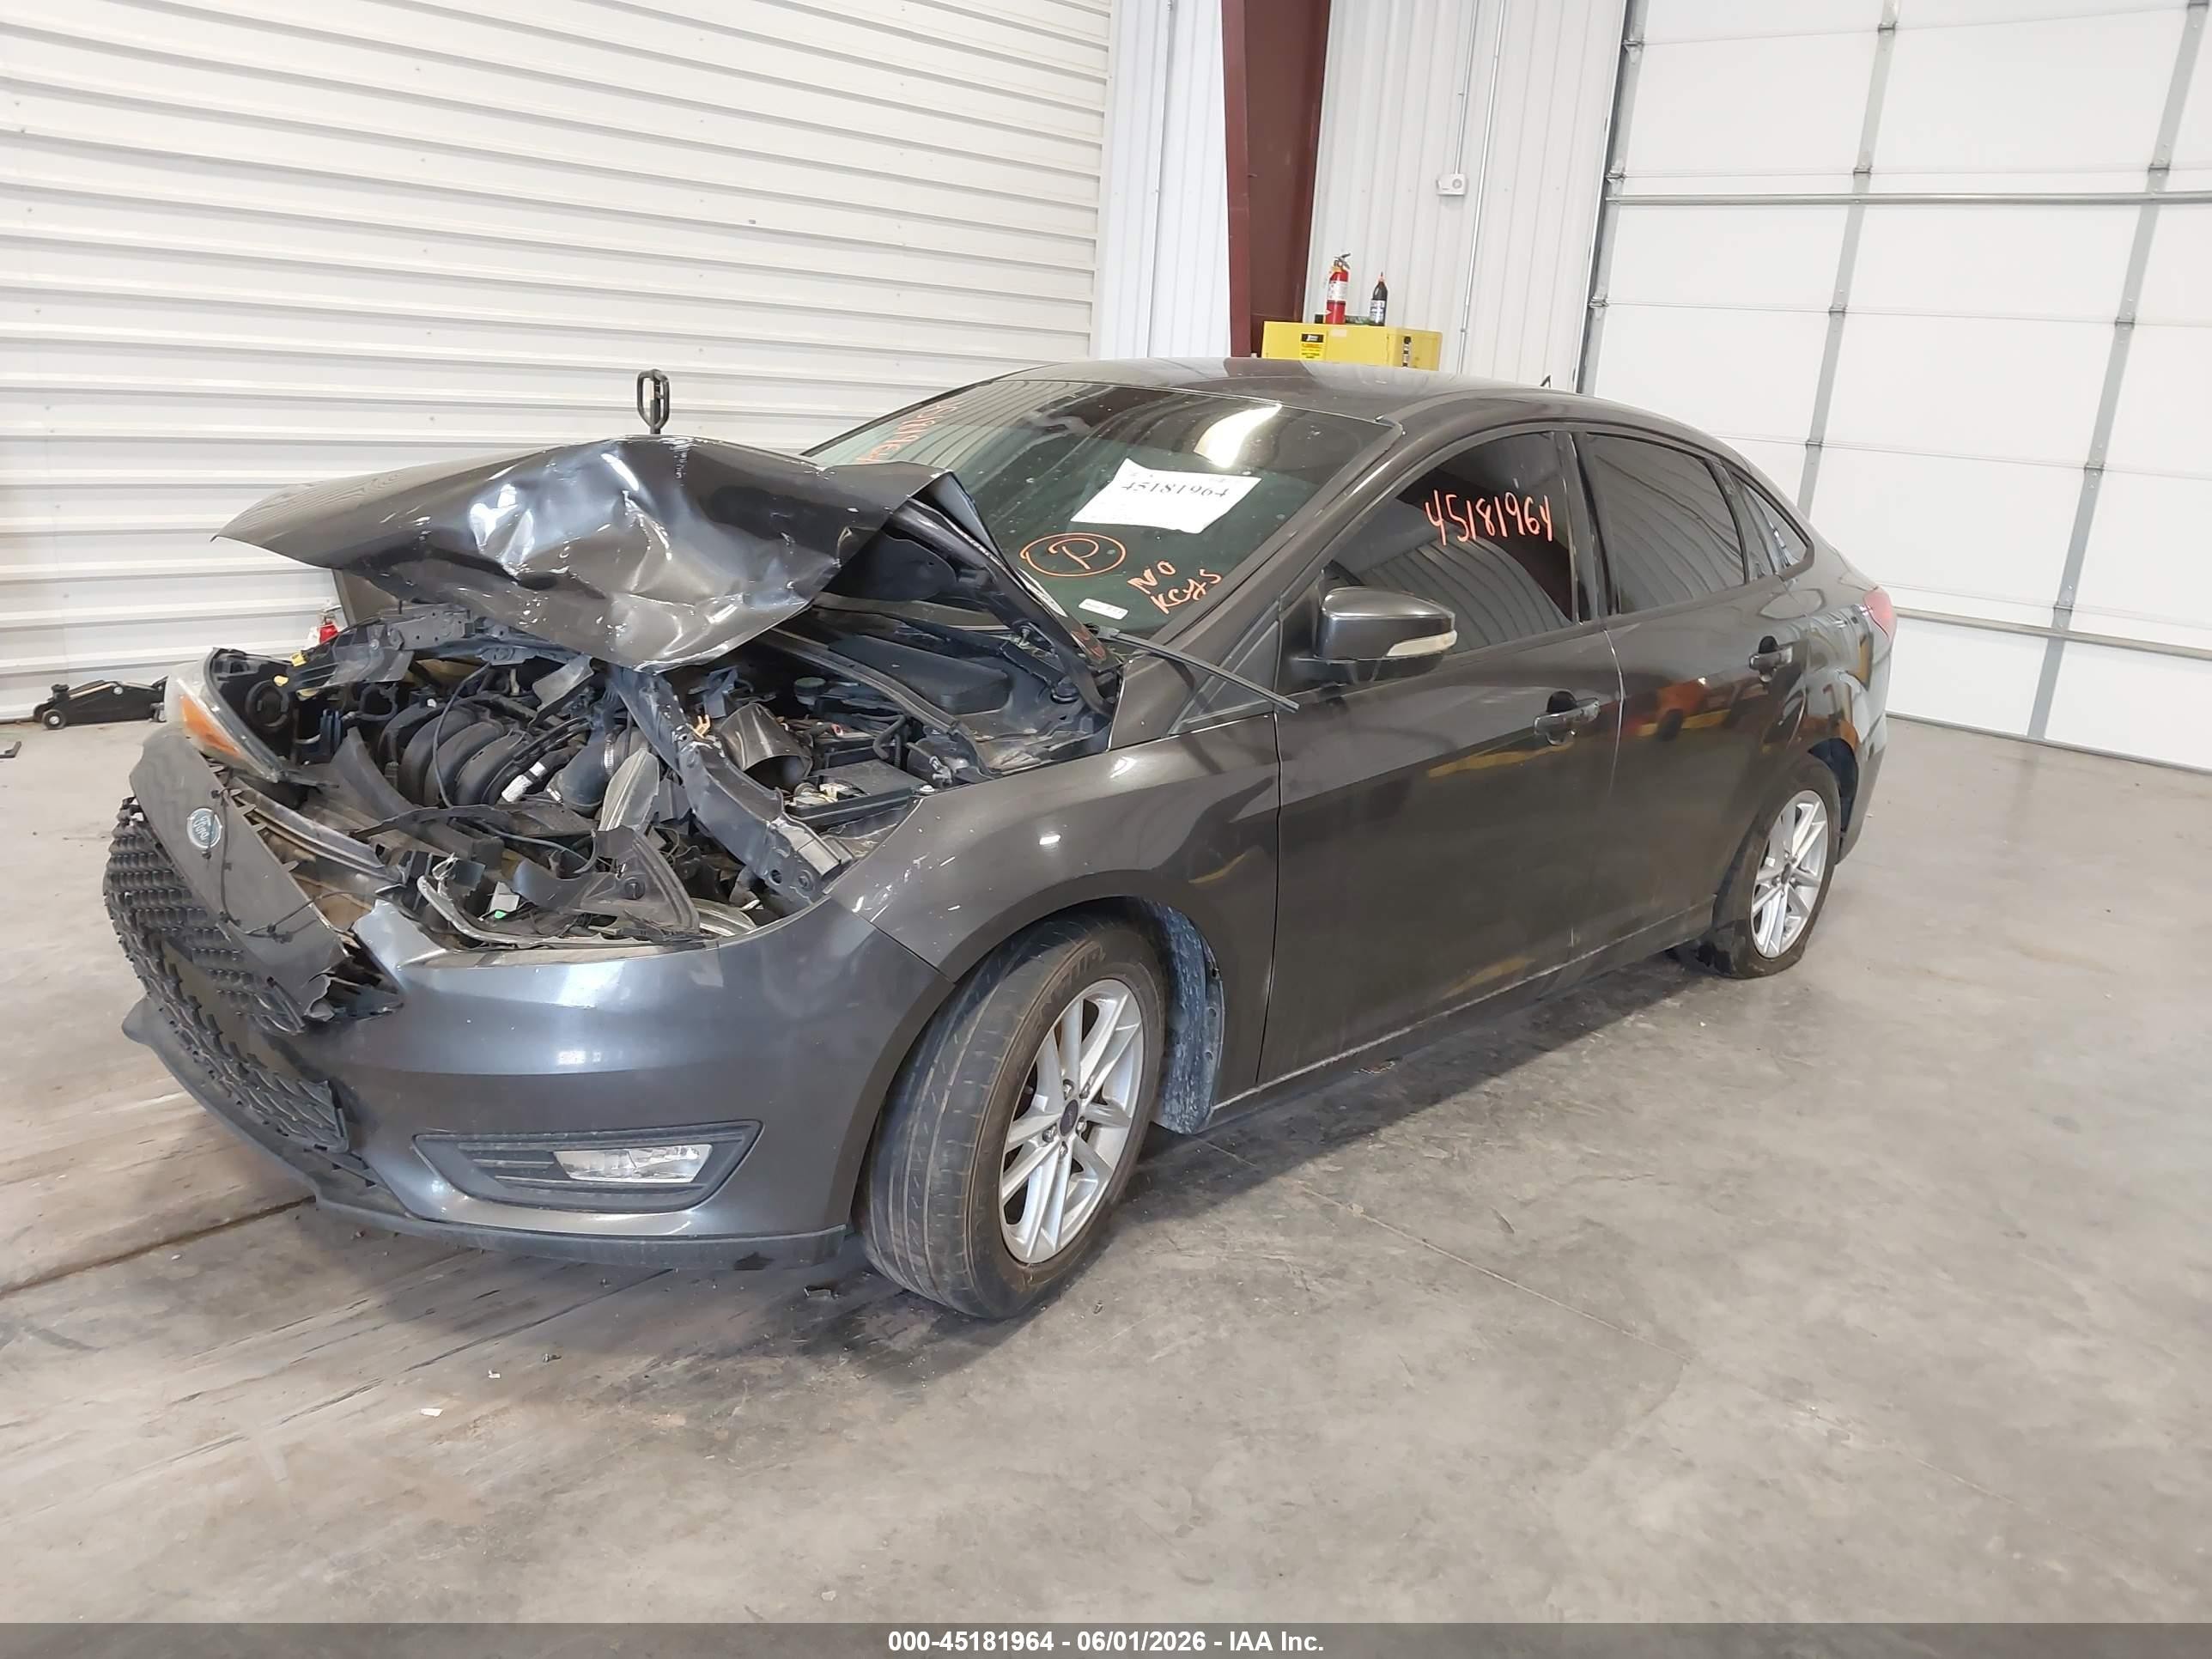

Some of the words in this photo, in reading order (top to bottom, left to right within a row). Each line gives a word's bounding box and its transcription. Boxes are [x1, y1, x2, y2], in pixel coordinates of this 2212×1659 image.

[1122, 483, 1229, 497] 45181964
[1425, 489, 1553, 546] 45181964
[1048, 538, 1099, 569] P
[1127, 560, 1176, 594] NO
